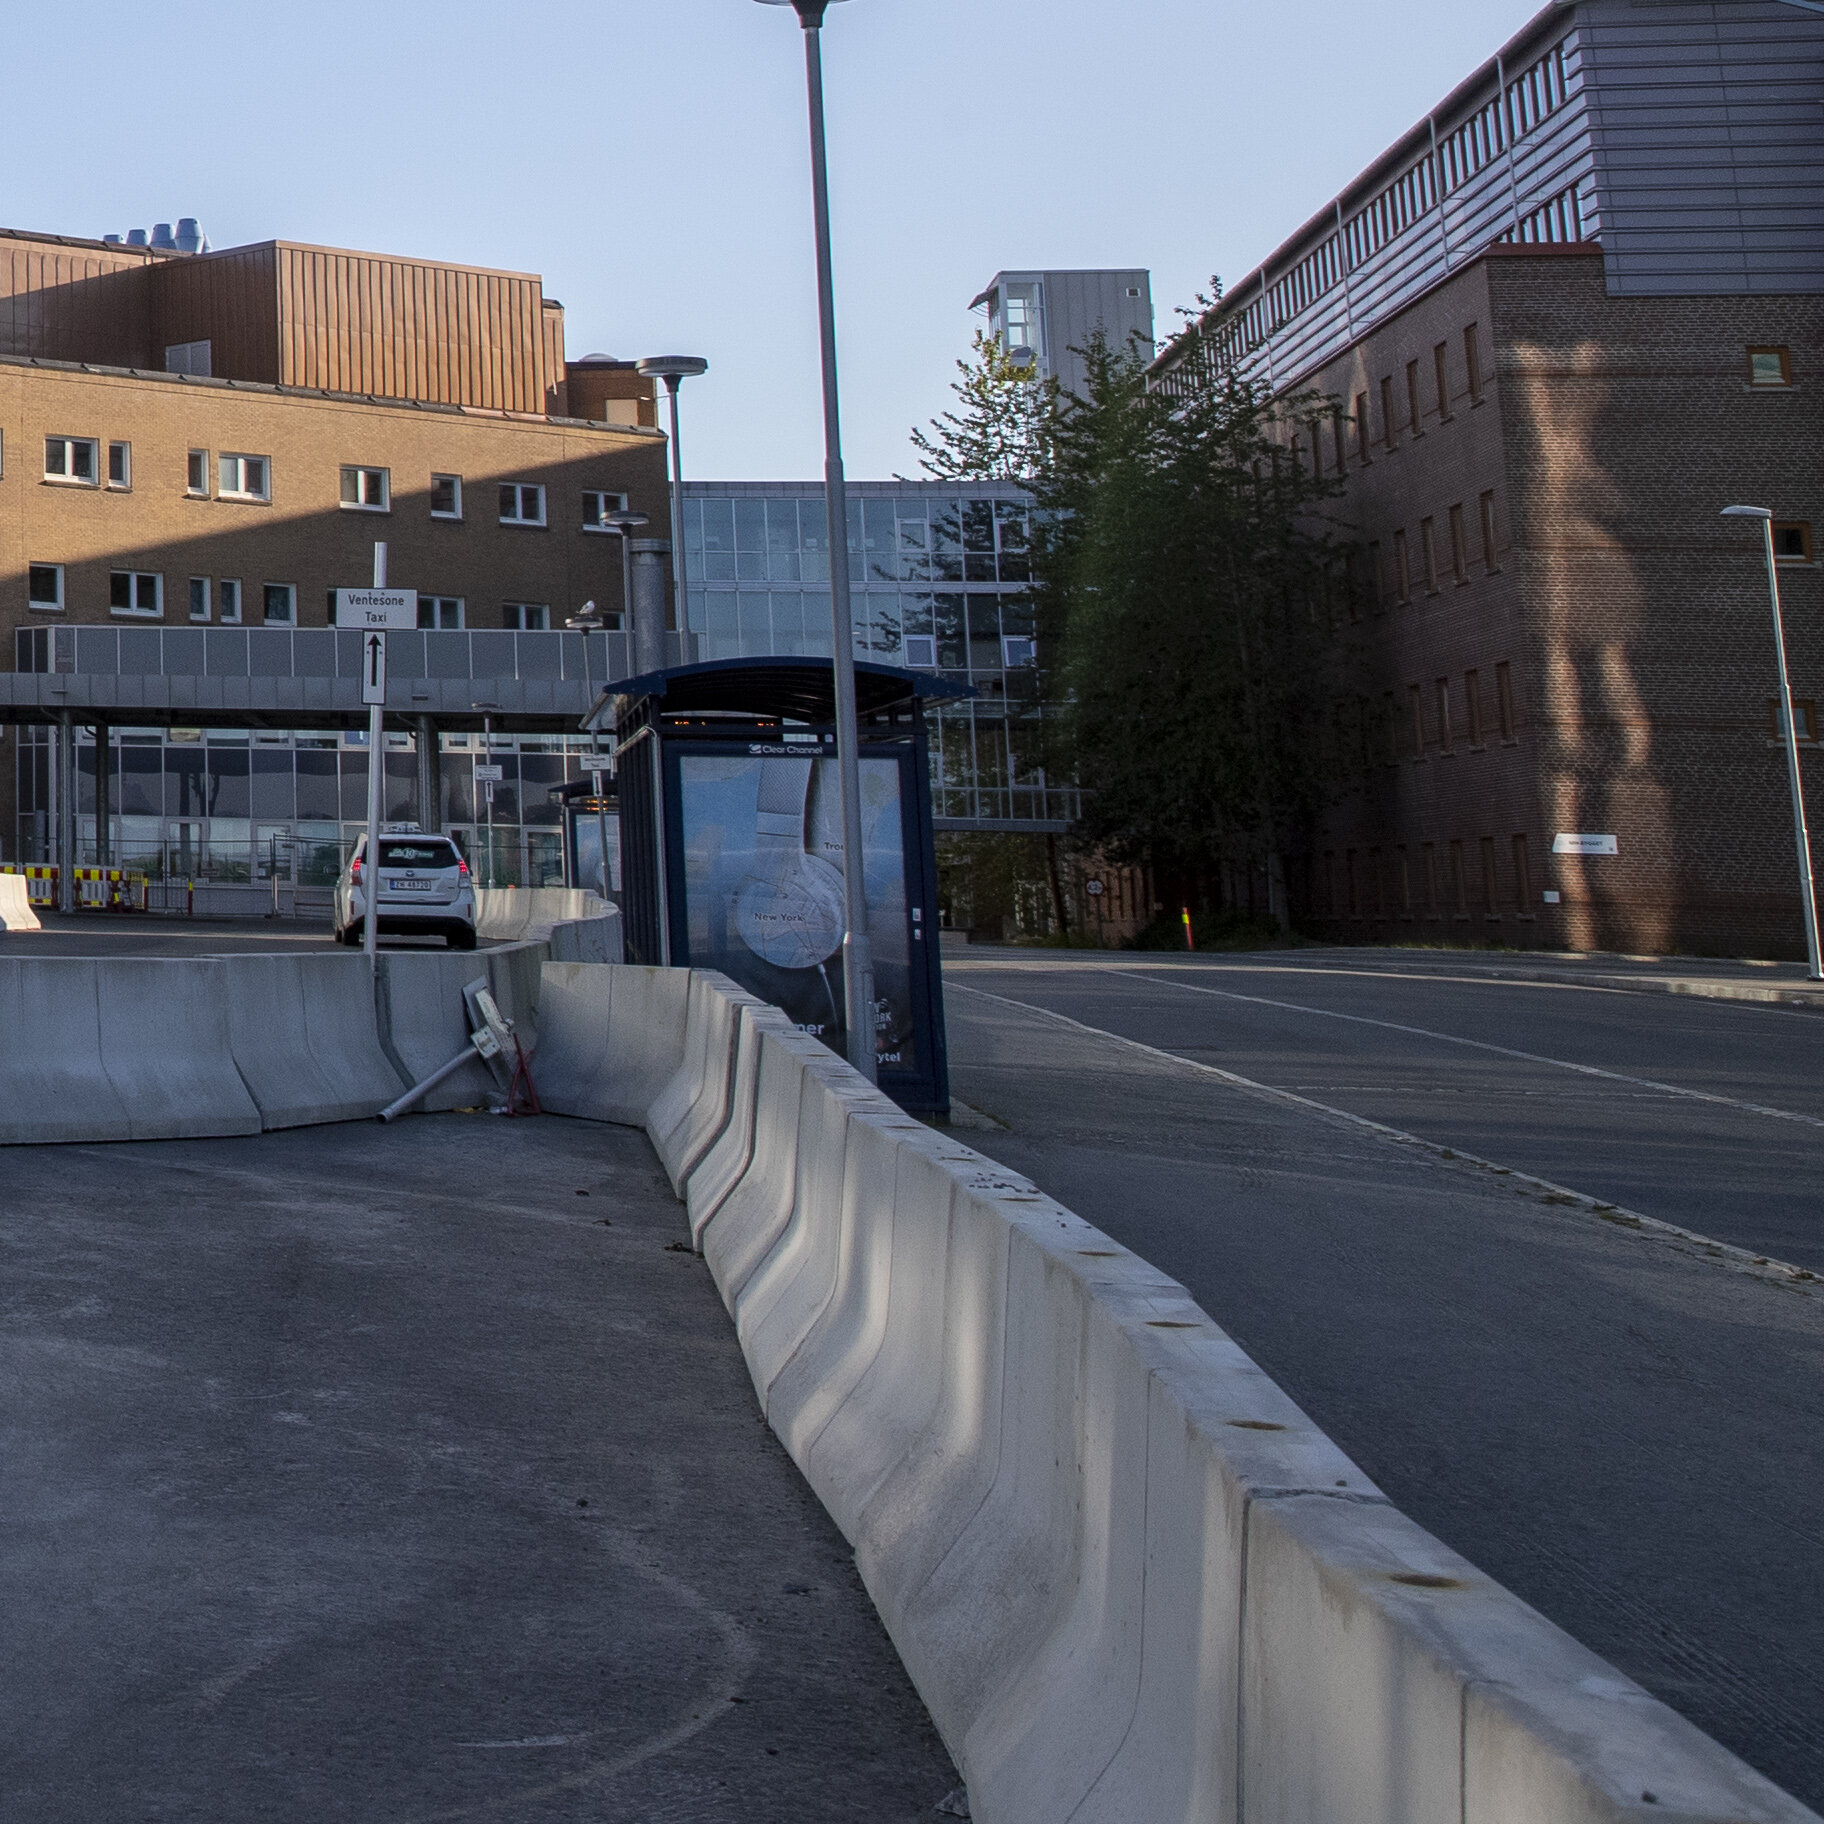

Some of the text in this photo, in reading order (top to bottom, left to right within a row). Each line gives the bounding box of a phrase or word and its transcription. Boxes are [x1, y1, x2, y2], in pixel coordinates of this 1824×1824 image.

[348, 594, 405, 606] Ventesone
[365, 611, 387, 623] Taxi
[762, 745, 823, 754] Clear Channel
[754, 912, 804, 922] New York
